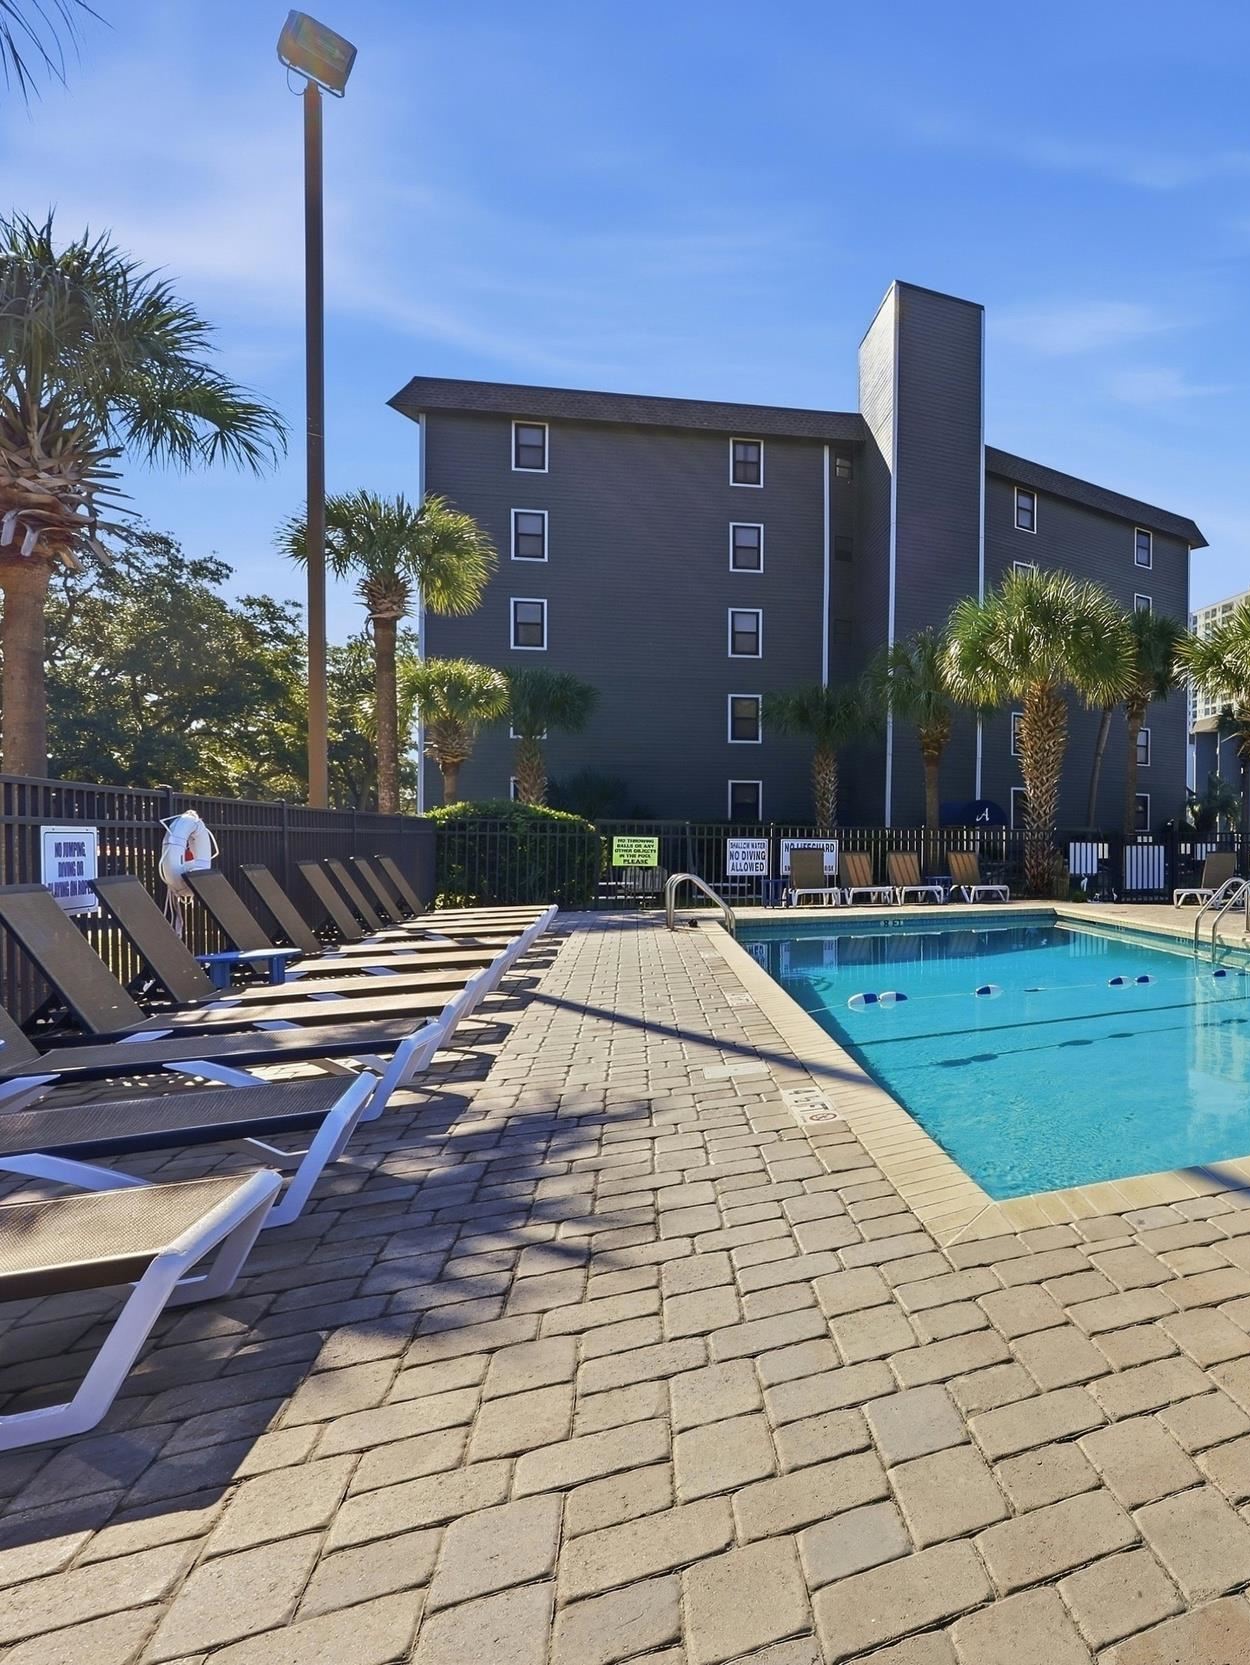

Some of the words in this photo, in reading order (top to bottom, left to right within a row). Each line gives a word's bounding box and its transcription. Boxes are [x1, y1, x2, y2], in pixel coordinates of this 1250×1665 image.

[54, 842, 63, 858] NO
[729, 850, 740, 861] NO
[741, 850, 766, 861] DIVING
[58, 861, 76, 878] DIVING
[76, 861, 84, 877] OR
[731, 862, 765, 872] ALLOWED
[70, 880, 78, 897] ON
